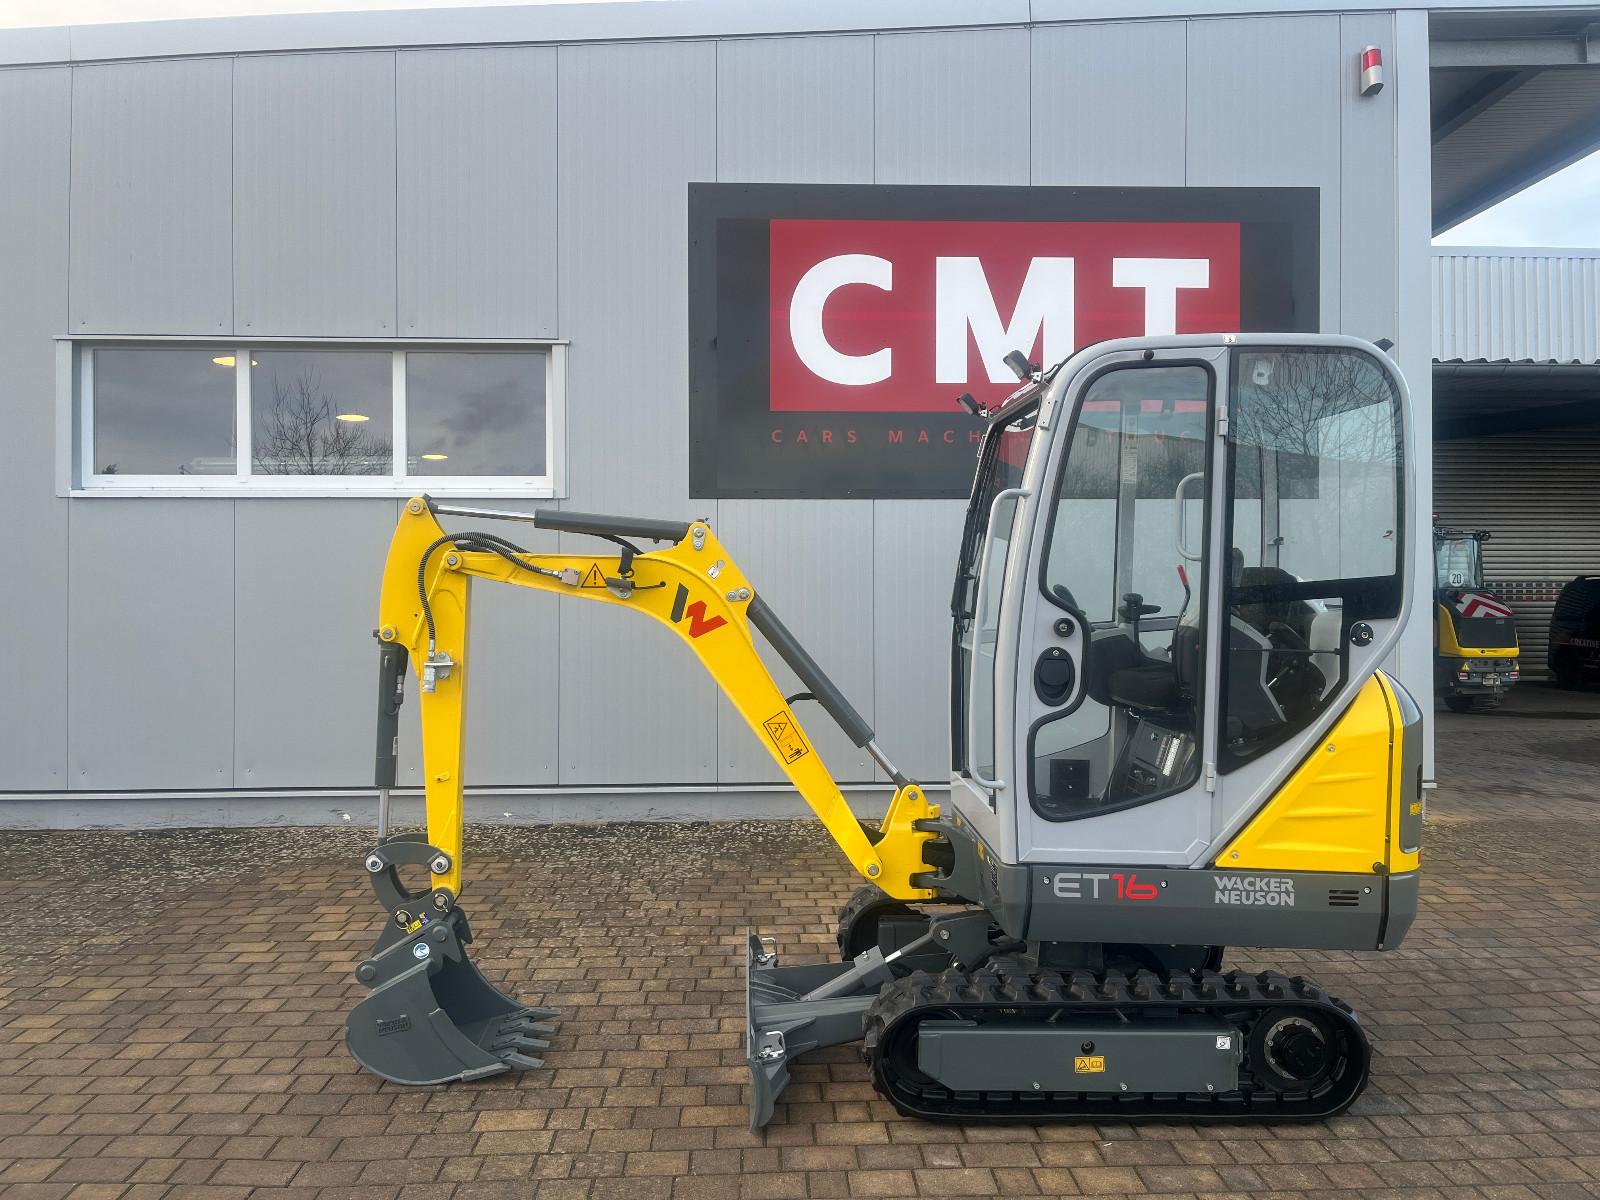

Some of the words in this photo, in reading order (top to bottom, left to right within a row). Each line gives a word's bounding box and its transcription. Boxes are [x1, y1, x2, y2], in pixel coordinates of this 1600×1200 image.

[789, 253, 1210, 386] CMT
[771, 429, 858, 443] CARS
[888, 429, 981, 443] MACH
[1451, 573, 1462, 584] 20
[1053, 872, 1159, 900] ET16
[1213, 876, 1295, 892] WACKER
[1214, 890, 1295, 906] NEUSON
